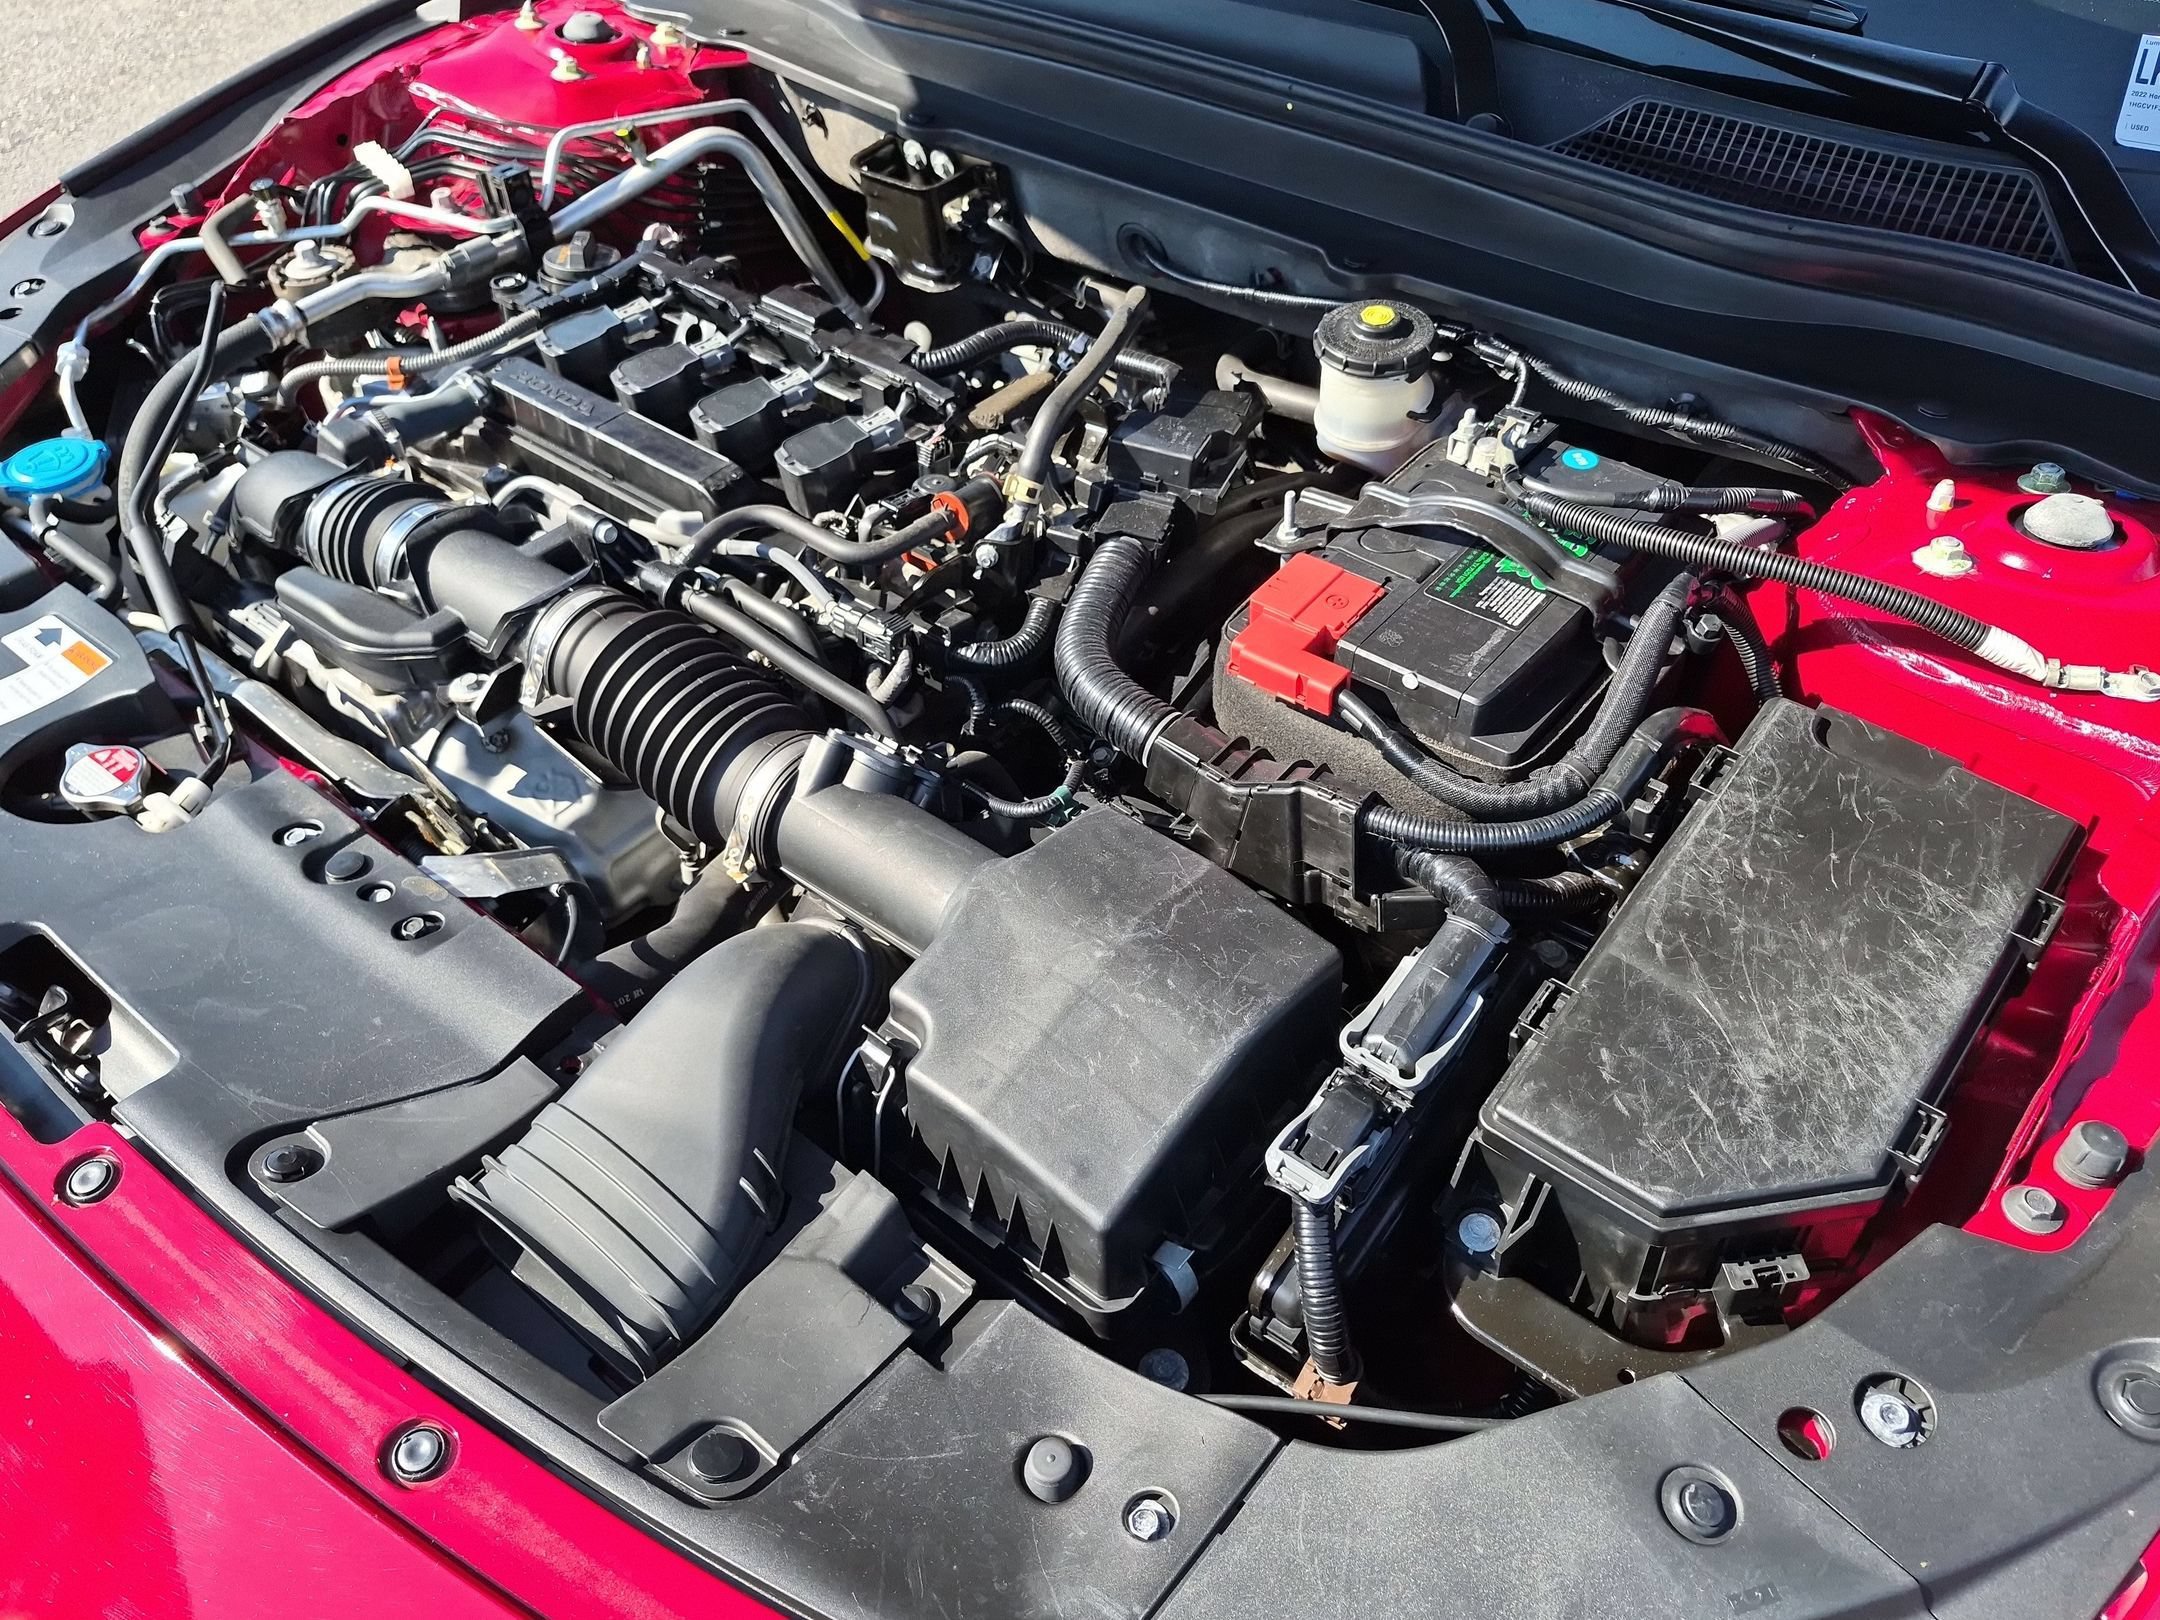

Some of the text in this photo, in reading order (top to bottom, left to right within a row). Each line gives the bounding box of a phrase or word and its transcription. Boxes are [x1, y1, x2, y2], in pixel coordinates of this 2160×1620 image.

[2131, 90, 2148, 98] 2022
[2130, 124, 2149, 132] USED
[509, 370, 596, 417] HONDA
